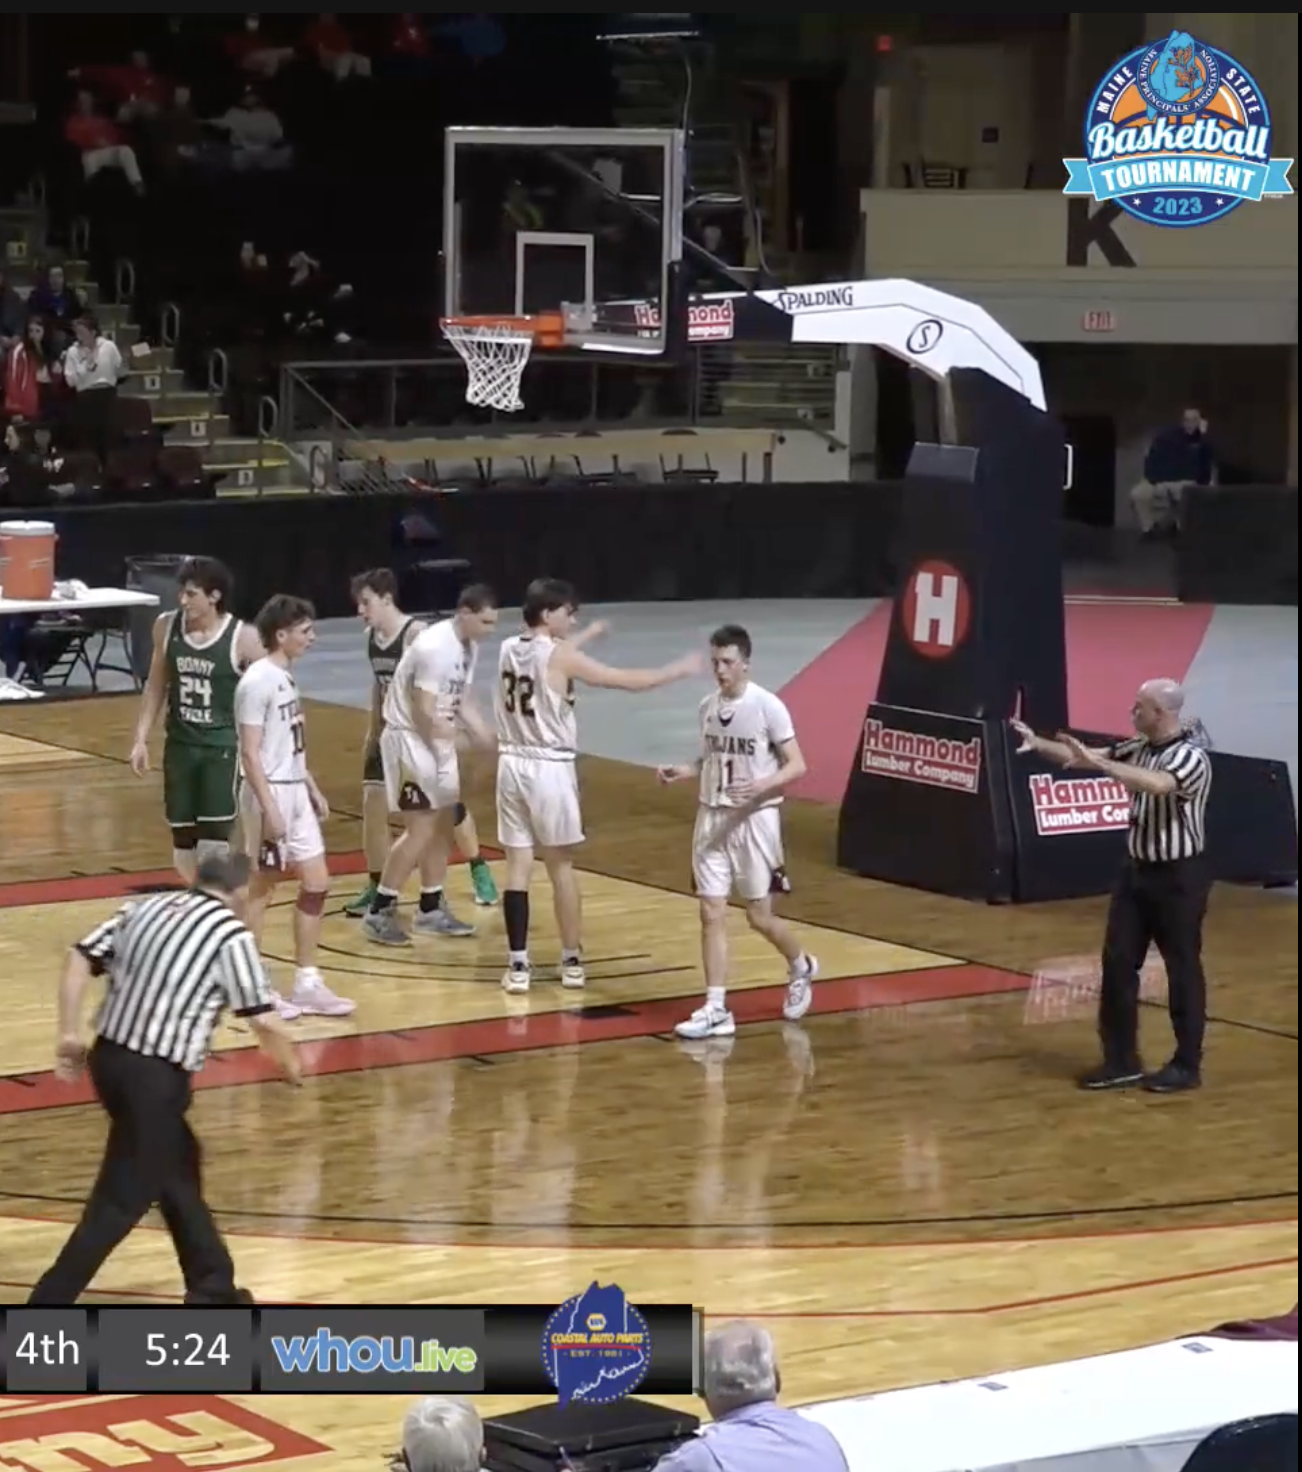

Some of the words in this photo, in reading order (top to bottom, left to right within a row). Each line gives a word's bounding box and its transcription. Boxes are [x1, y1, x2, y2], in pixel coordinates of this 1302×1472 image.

[1066, 197, 1137, 267] K
[775, 286, 854, 311] SPALDING
[913, 571, 958, 647] H
[176, 656, 215, 676] BONNY
[179, 675, 212, 706] 24
[502, 670, 535, 717] 32
[865, 719, 979, 766] Hammond
[866, 750, 911, 773] Lumber
[913, 761, 975, 788] Company
[1030, 774, 1128, 806] Hamm
[1040, 808, 1098, 828] Lumber
